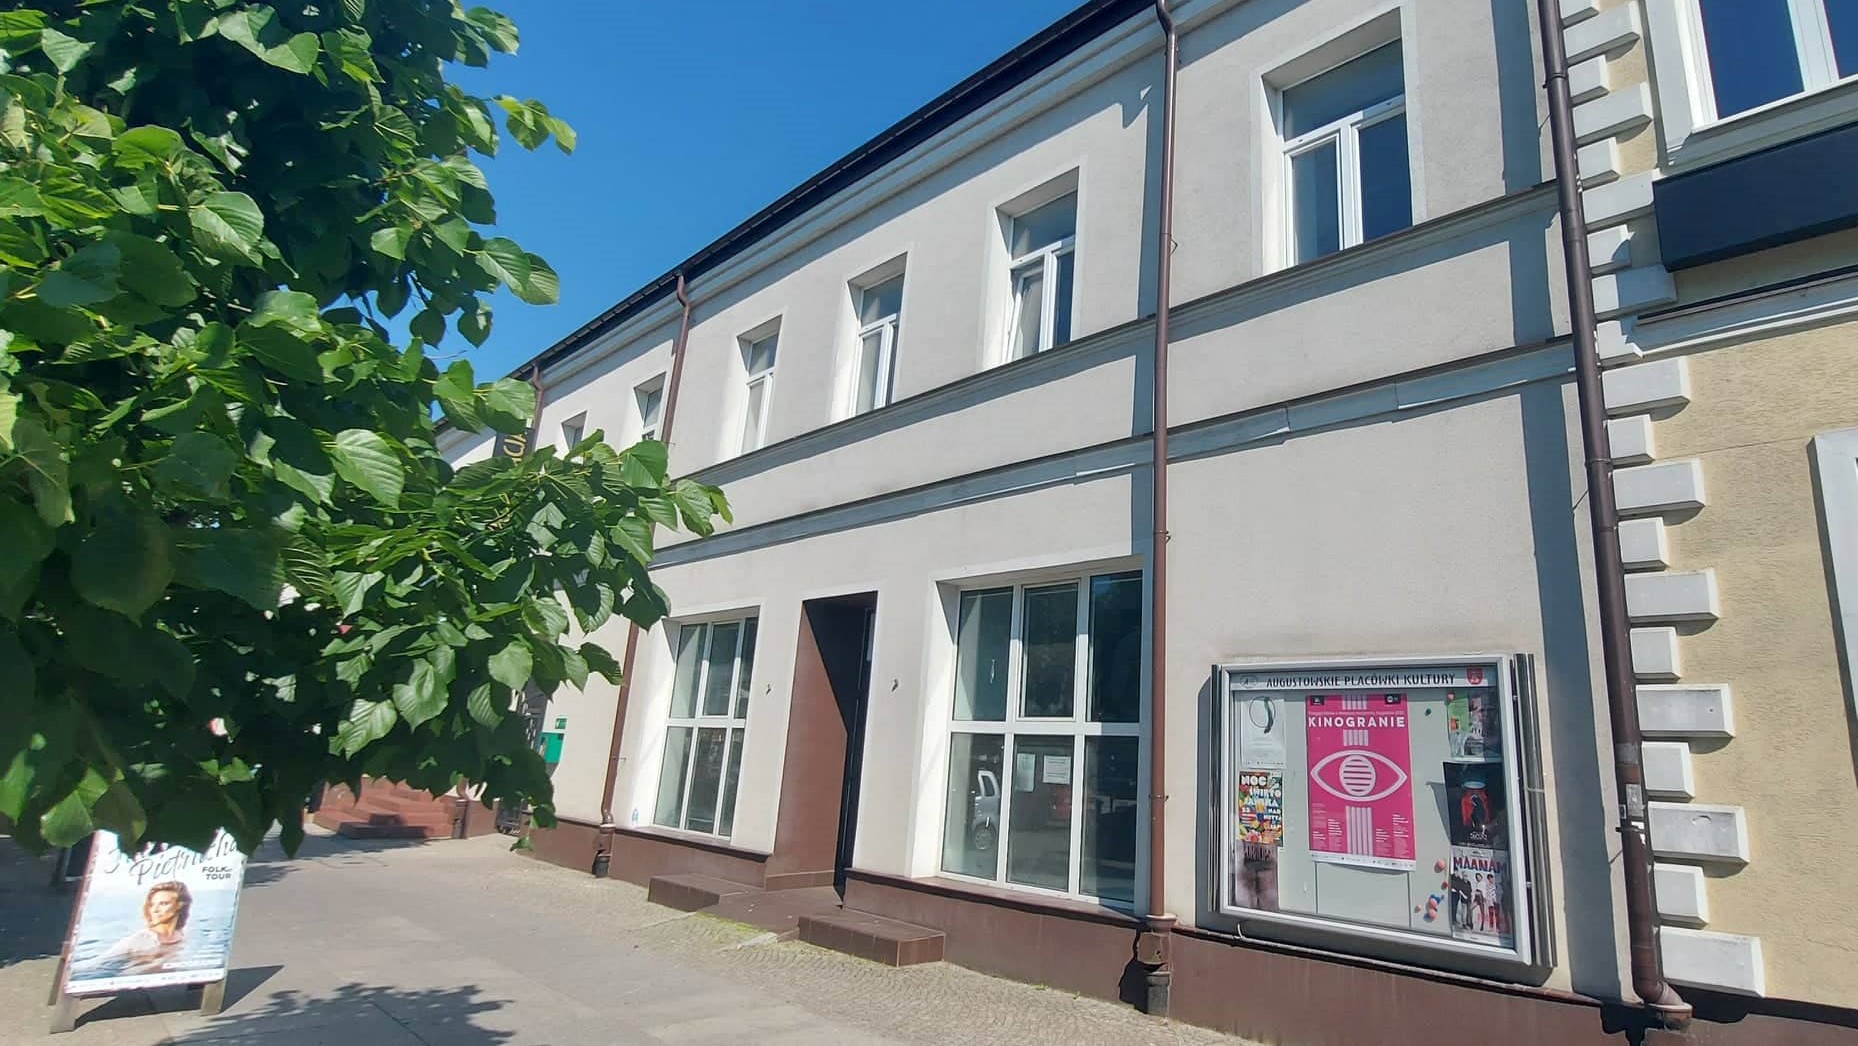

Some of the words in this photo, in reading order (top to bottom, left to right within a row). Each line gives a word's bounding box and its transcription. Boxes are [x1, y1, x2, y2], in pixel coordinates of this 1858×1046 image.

[1266, 676, 1341, 688] AUGUSTOWSKIE
[1344, 673, 1400, 686] PLACÓWKI
[1404, 672, 1456, 685] KULTURY
[1307, 716, 1406, 728] KINOGRANIE
